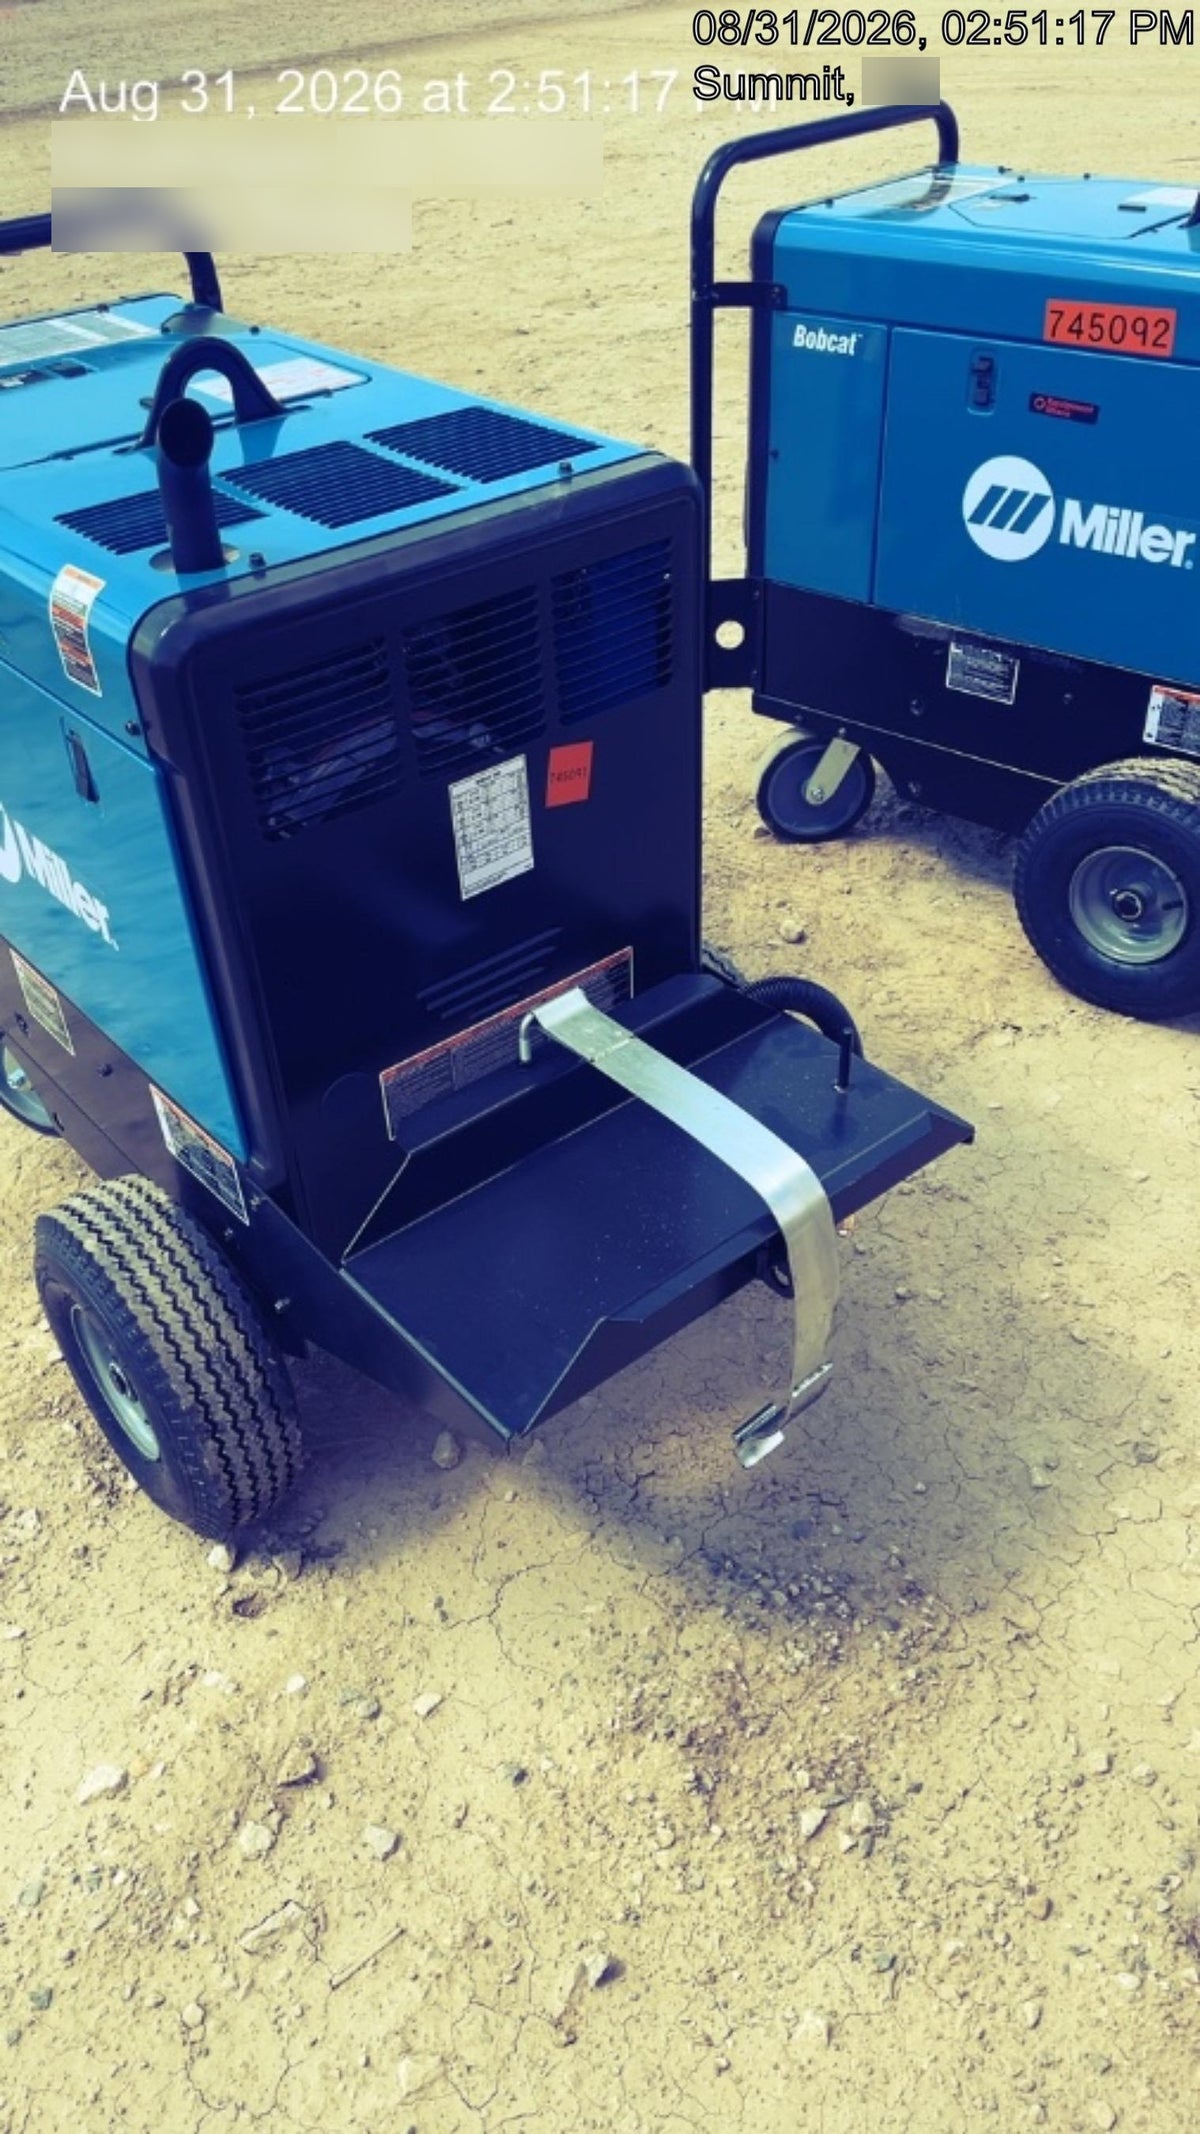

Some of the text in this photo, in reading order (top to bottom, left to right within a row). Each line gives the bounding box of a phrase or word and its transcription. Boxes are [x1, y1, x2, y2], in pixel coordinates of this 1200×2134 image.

[793, 324, 857, 356] Bobcat
[1050, 309, 1171, 349] 745092
[1059, 498, 1196, 568] Miller
